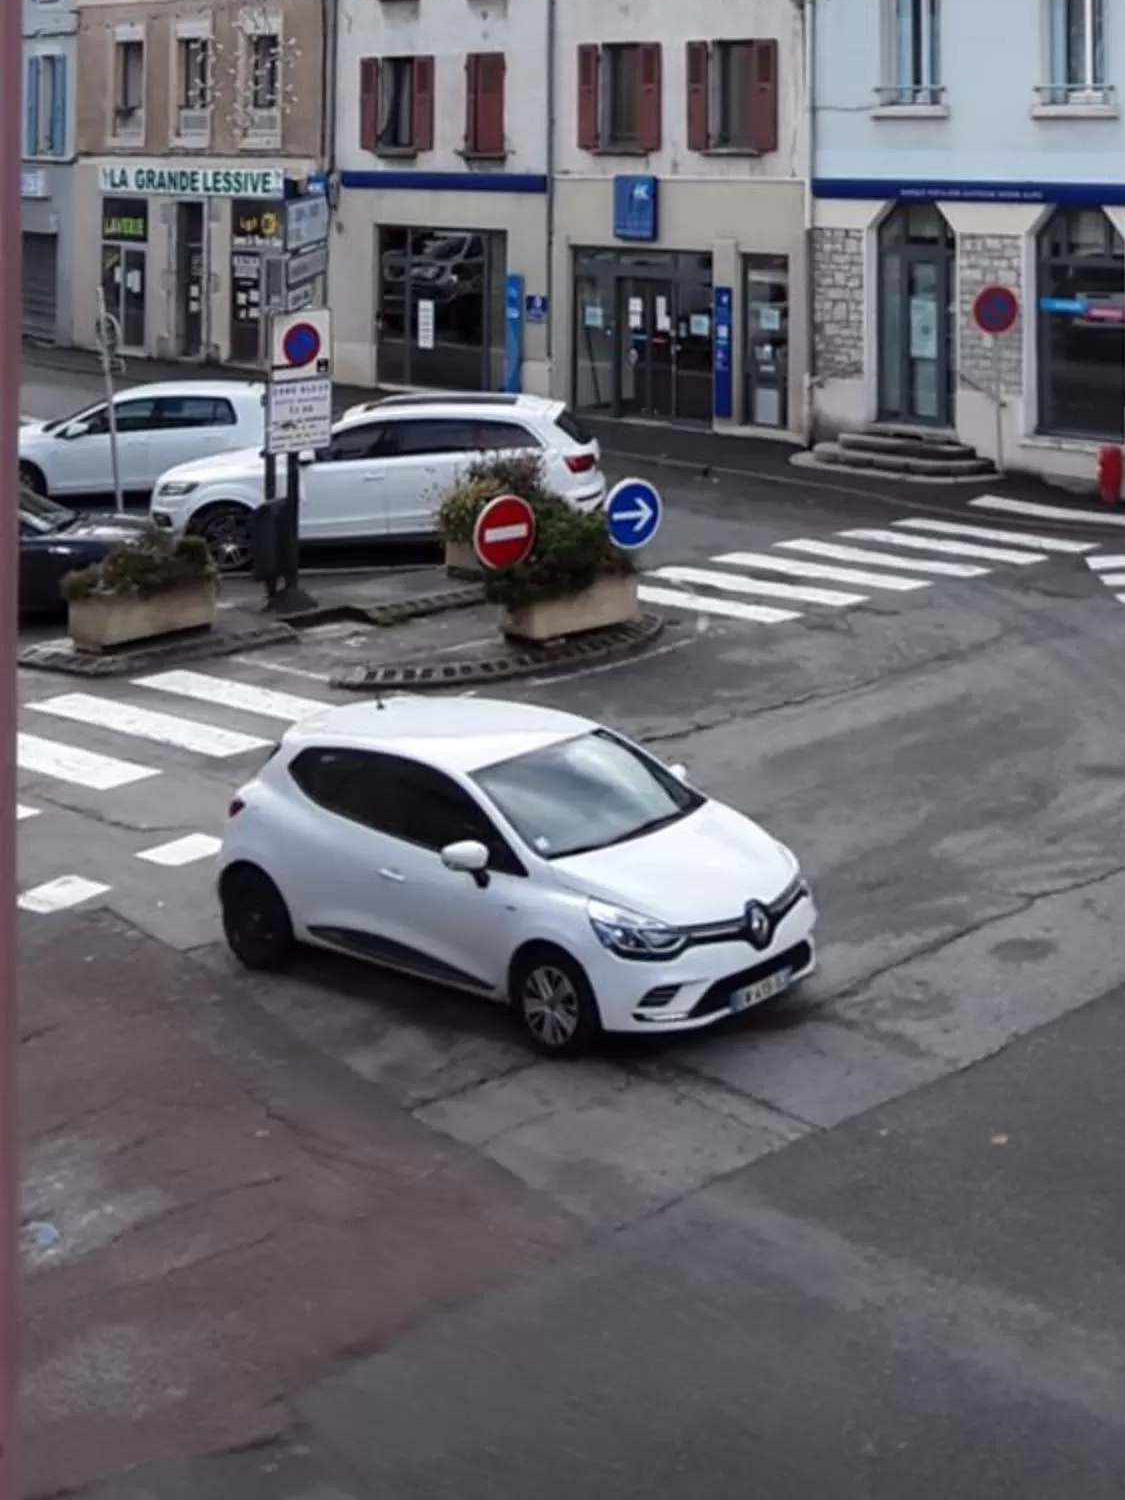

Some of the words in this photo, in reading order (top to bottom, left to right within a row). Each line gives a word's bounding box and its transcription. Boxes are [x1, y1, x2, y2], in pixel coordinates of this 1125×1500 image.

[110, 168, 128, 188] LA
[135, 169, 204, 192] GRANDE
[203, 171, 272, 193] LESSIVE
